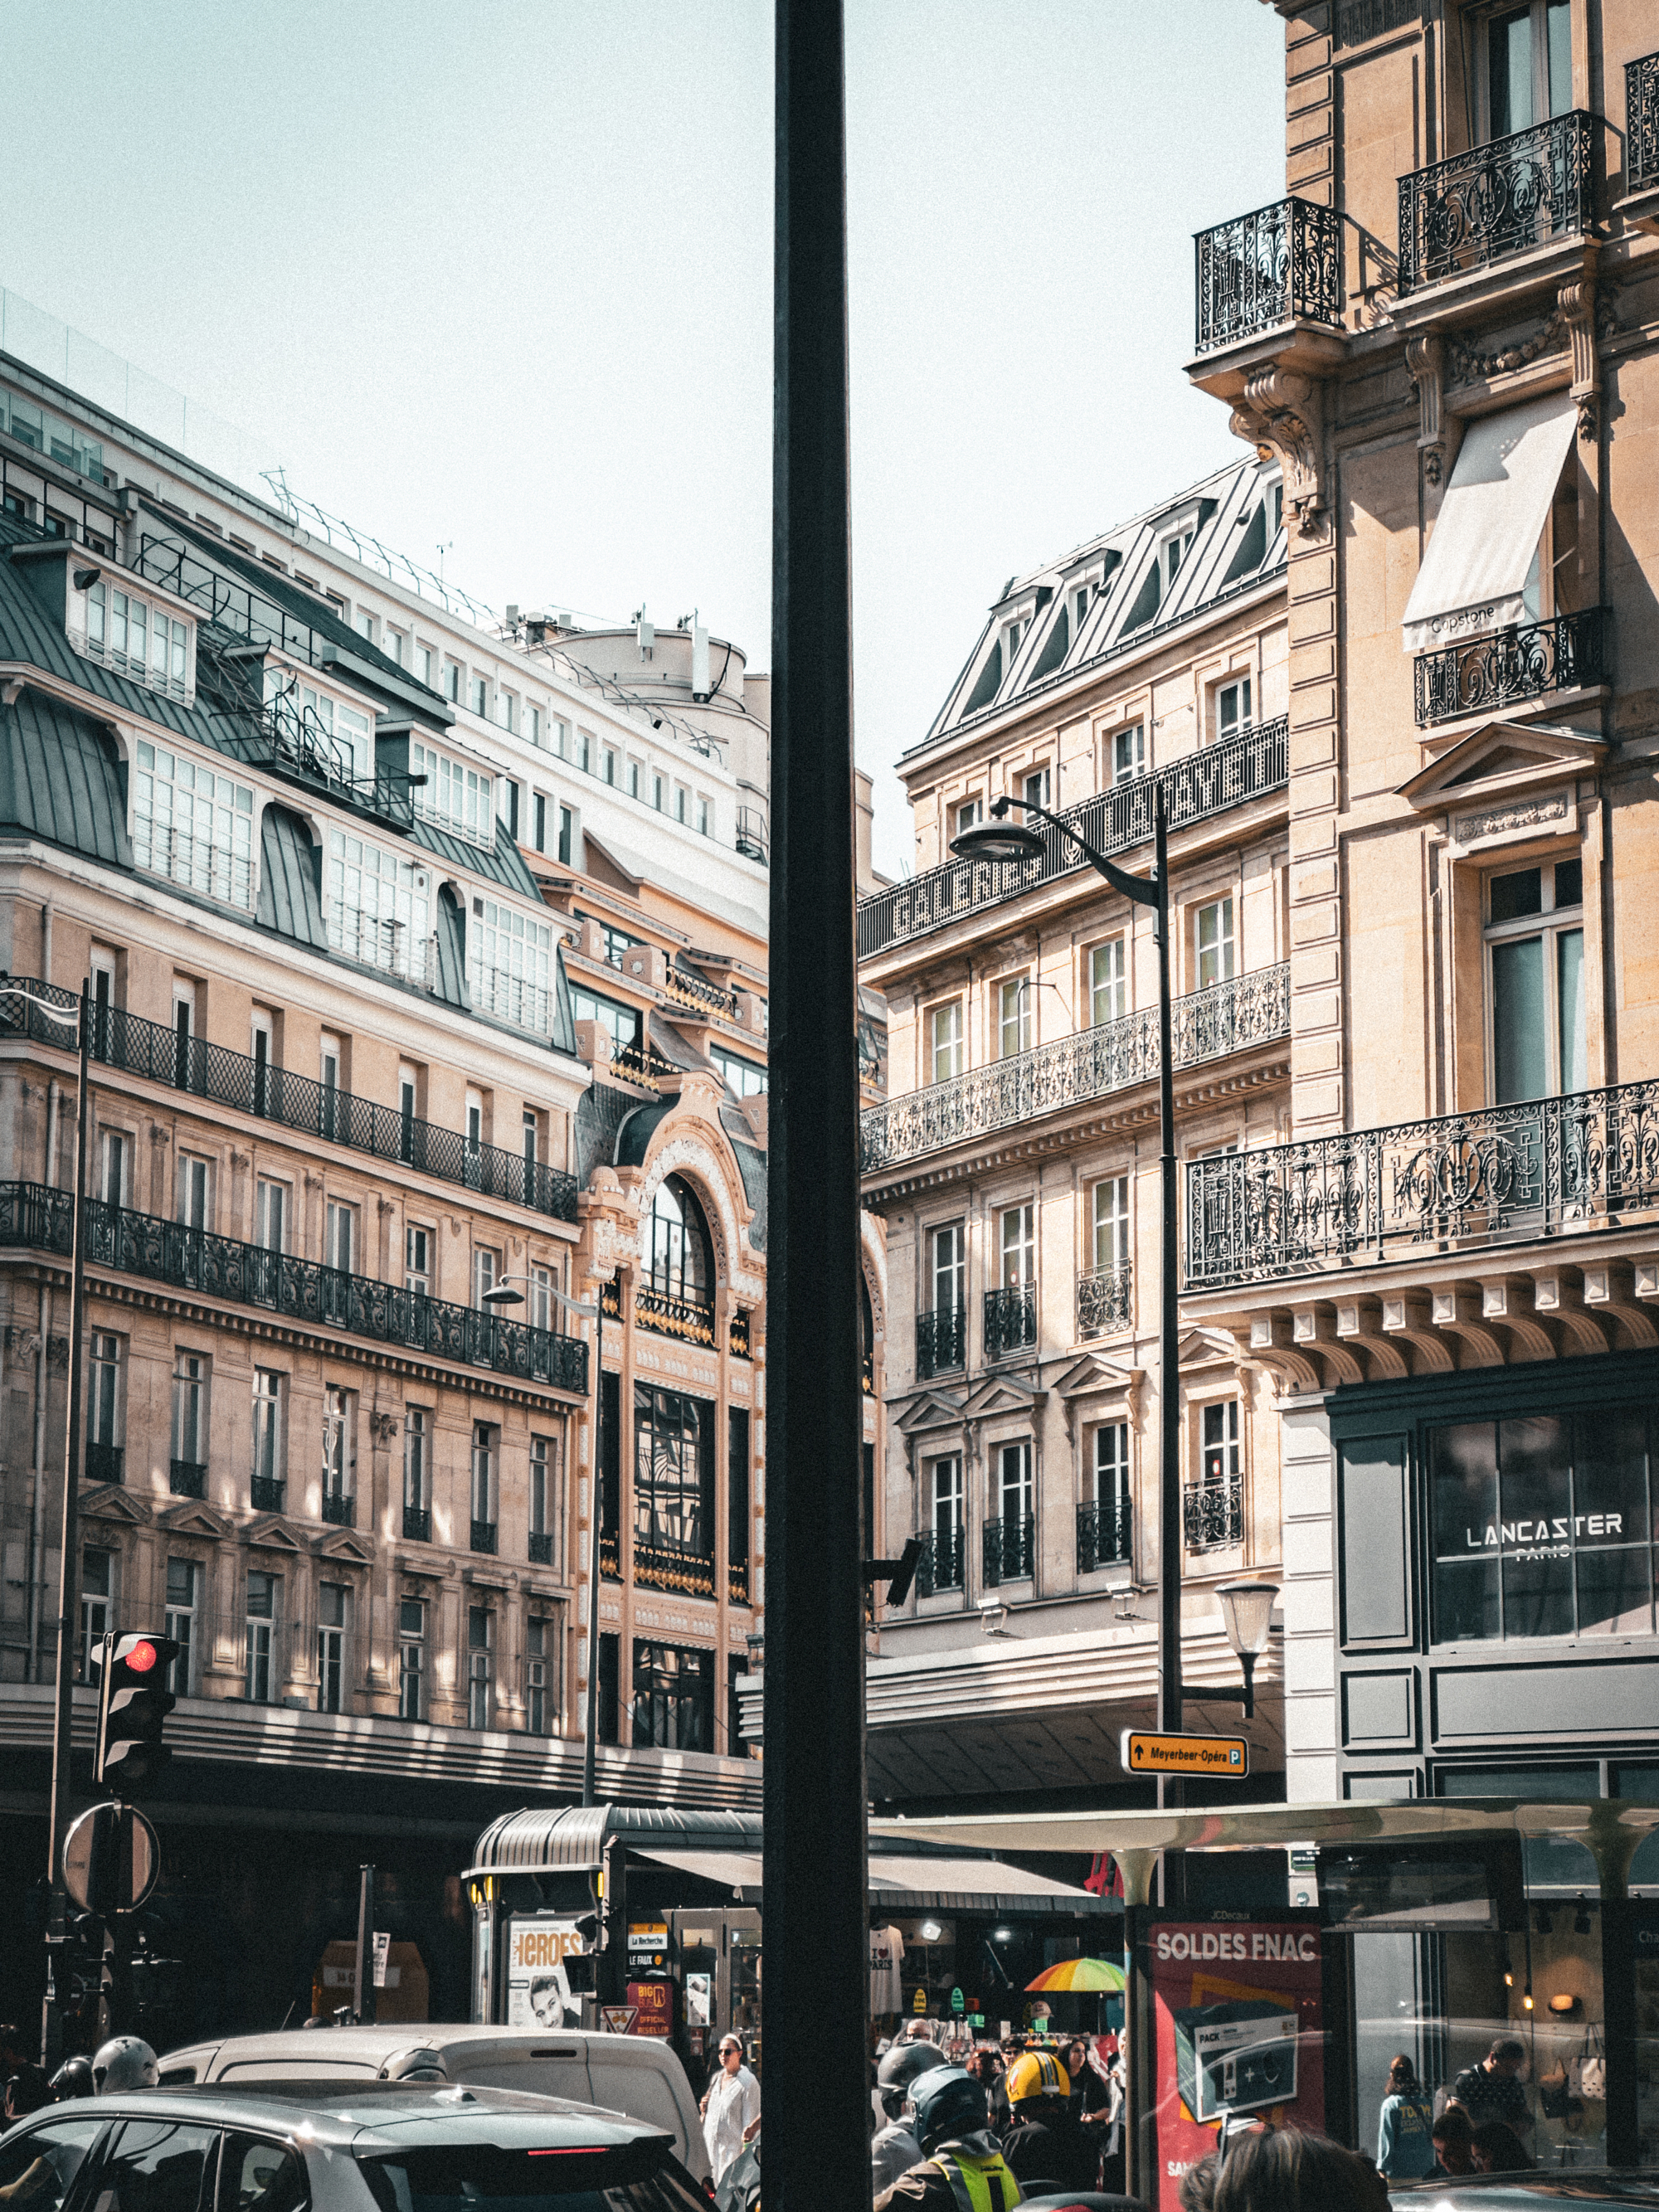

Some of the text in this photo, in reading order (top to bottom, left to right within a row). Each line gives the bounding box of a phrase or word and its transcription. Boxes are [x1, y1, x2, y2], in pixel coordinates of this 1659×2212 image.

[1431, 607, 1495, 633] Capstone
[1467, 1514, 1623, 1547] LANCASTER
[1515, 1544, 1570, 1562] PARIS
[1151, 1747, 1239, 1764] Meyerbeer-Opéra P
[1211, 1910, 1251, 1920] JCDecaux
[631, 1936, 664, 1946] La Recherche
[1157, 1932, 1316, 1962] SOLDES FNAC
[872, 1947, 878, 1959] I
[629, 1955, 653, 1966] LE FAUX
[638, 1986, 654, 1998] BIG
[1199, 2031, 1220, 2044] PACK
